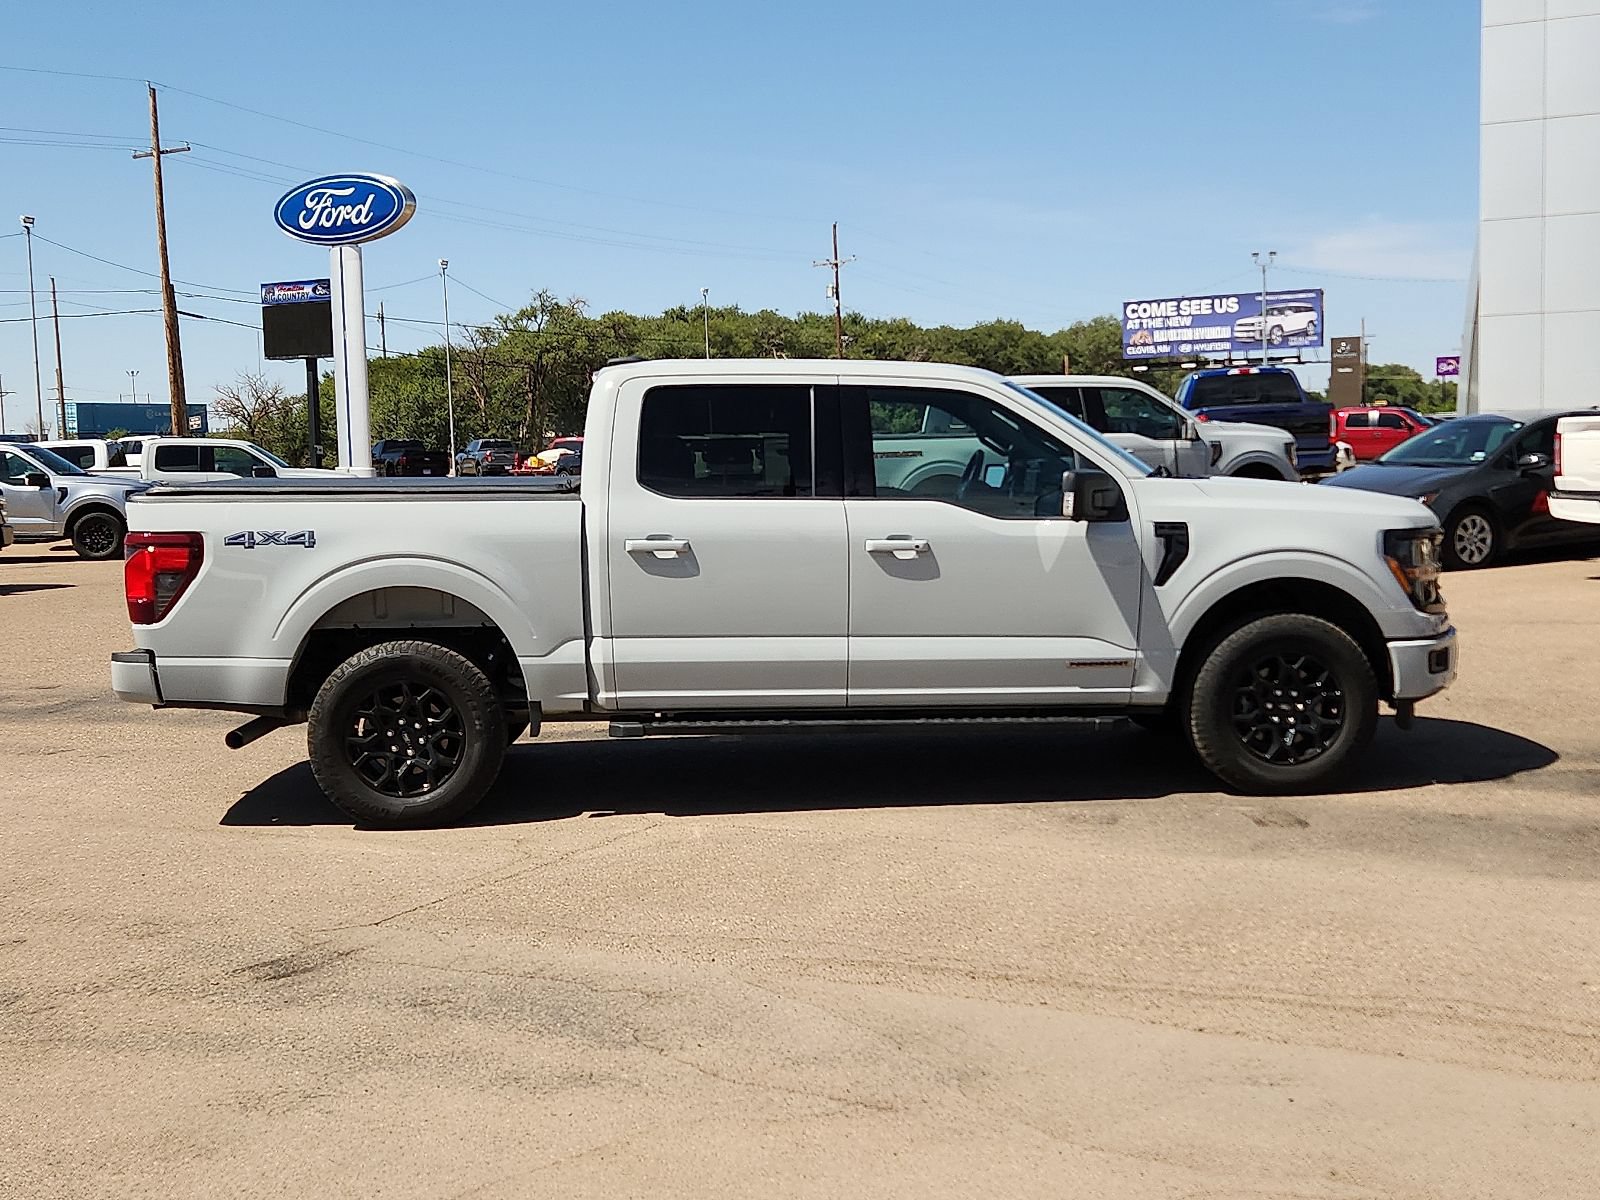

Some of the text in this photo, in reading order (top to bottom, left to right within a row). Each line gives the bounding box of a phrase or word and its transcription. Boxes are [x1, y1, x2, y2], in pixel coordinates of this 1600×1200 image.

[298, 187, 375, 230] Ford
[277, 292, 310, 301] COUNTRY
[1126, 297, 1239, 318] COME SEE US
[1127, 316, 1192, 329] AT THE NEW
